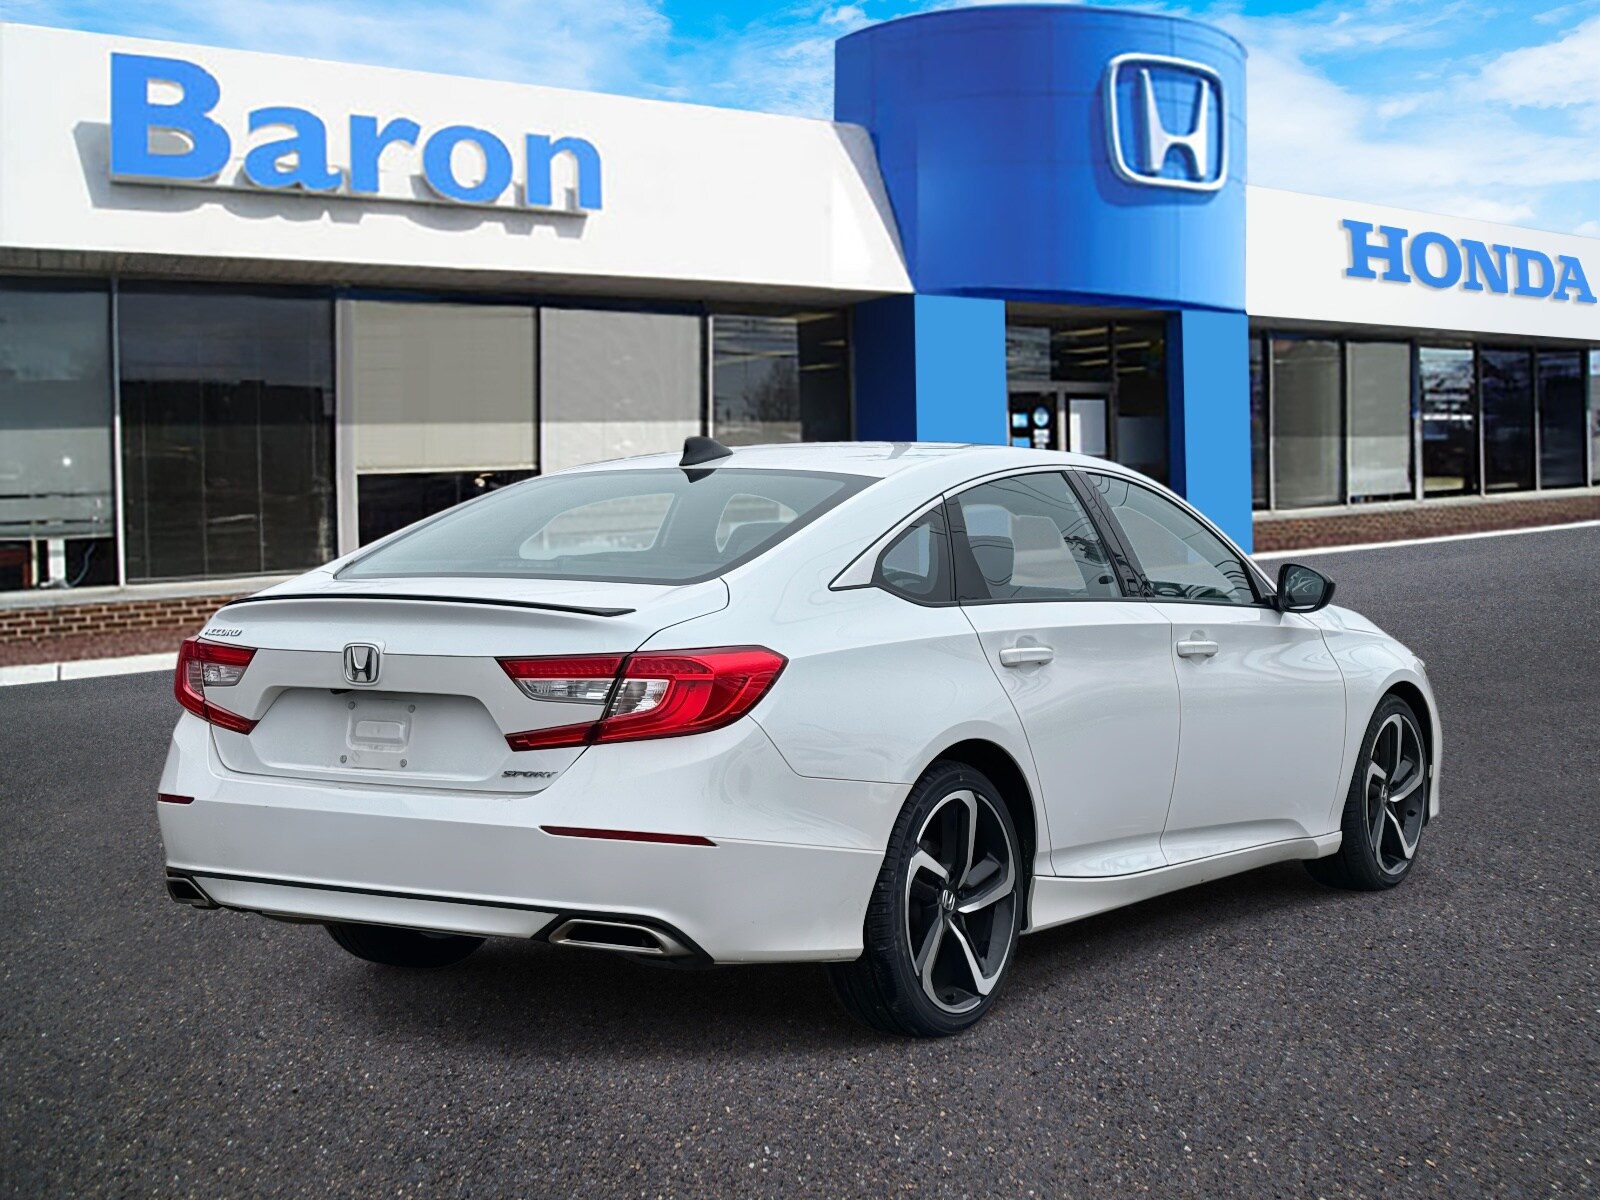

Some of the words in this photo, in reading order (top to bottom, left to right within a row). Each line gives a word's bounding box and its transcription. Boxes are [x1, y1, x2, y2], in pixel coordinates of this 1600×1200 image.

[110, 52, 602, 210] Baron
[1343, 219, 1597, 304] HONDA
[204, 628, 243, 637] ACCORD
[501, 770, 559, 778] SPORT
